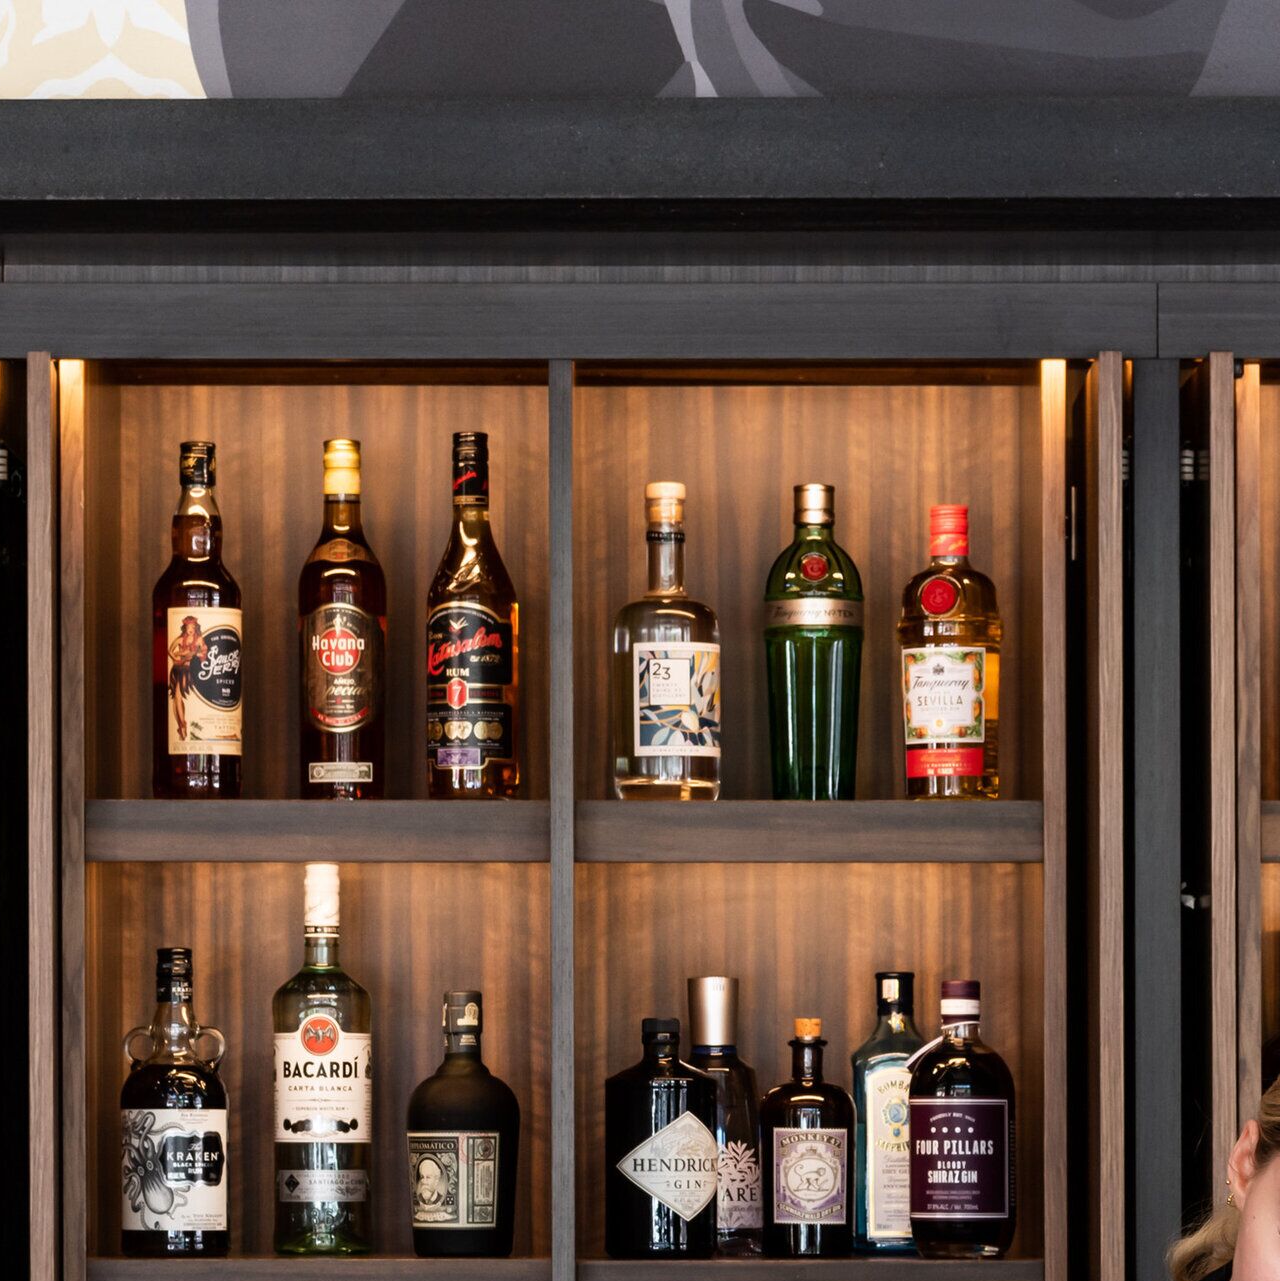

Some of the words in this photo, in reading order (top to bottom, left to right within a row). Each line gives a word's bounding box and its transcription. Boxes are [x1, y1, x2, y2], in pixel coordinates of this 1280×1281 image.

[312, 634, 365, 651] Havana
[321, 651, 355, 667] Club
[446, 667, 470, 677] RUM
[651, 662, 671, 681] 23
[912, 675, 971, 691] Tanqueray
[452, 685, 462, 702] 7
[917, 695, 964, 707] SEVILLA
[283, 1055, 358, 1079] BACARDÍ
[781, 1133, 829, 1147] MONKEY
[915, 1140, 939, 1155] FOUR
[943, 1140, 994, 1155] PILLARS
[166, 1151, 218, 1161] KRAKEN
[937, 1160, 967, 1170] BLOODY
[674, 1179, 702, 1189] GIN
[927, 1170, 960, 1184] SHIRAZ
[961, 1170, 979, 1184] GIN
[721, 1187, 759, 1202] ARE
